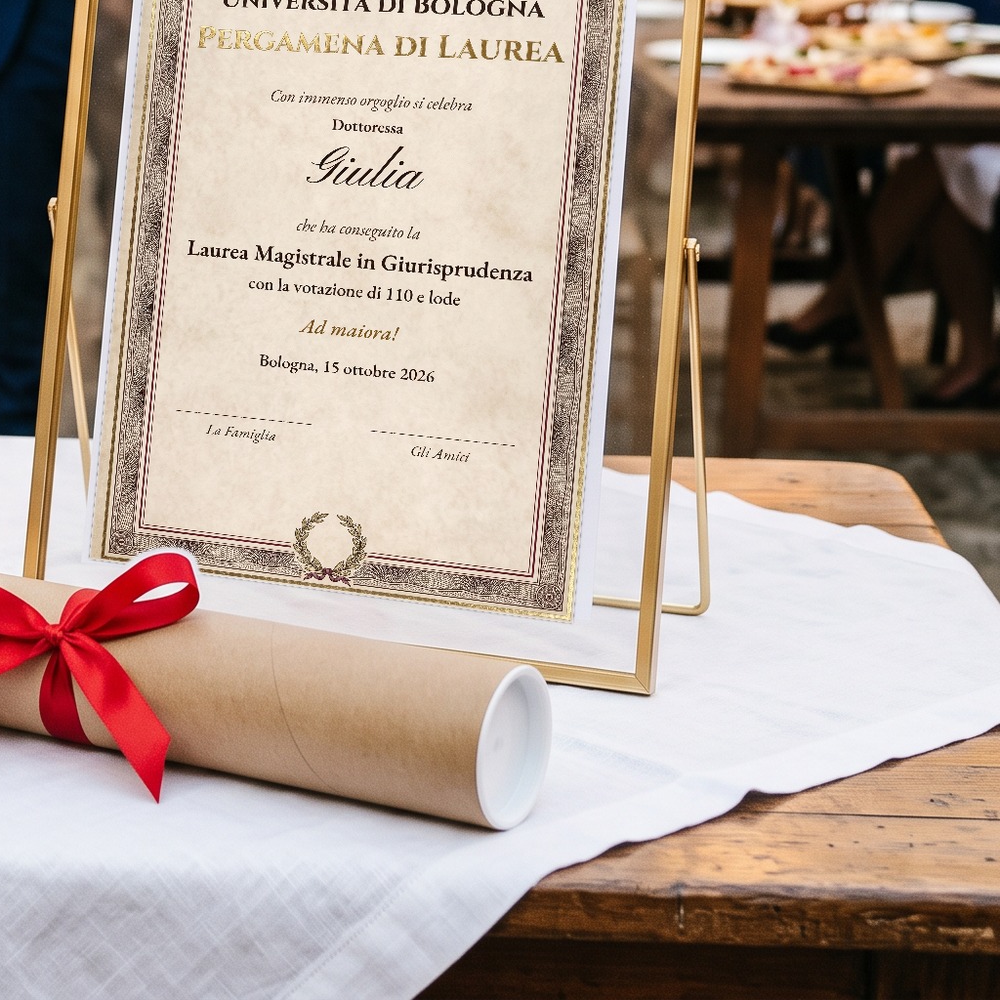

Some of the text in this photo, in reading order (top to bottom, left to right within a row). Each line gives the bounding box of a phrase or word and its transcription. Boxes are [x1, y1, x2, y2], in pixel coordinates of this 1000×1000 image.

[271, 90, 472, 113] Con immenso orgoglio si celebra
[332, 119, 403, 134] Dottoressa
[306, 146, 424, 189] Giulia
[297, 219, 420, 242] che ha conseguito la
[187, 240, 533, 282] Laurea Magistrale in Giurisprudenza
[249, 278, 460, 306] con la votazione di 110 e lode
[299, 319, 400, 341] Ad maiora!
[260, 354, 435, 382] Bologna, 15 ottobre 2026
[206, 425, 276, 444] La Famiglia
[411, 446, 470, 462] Gli Amici
